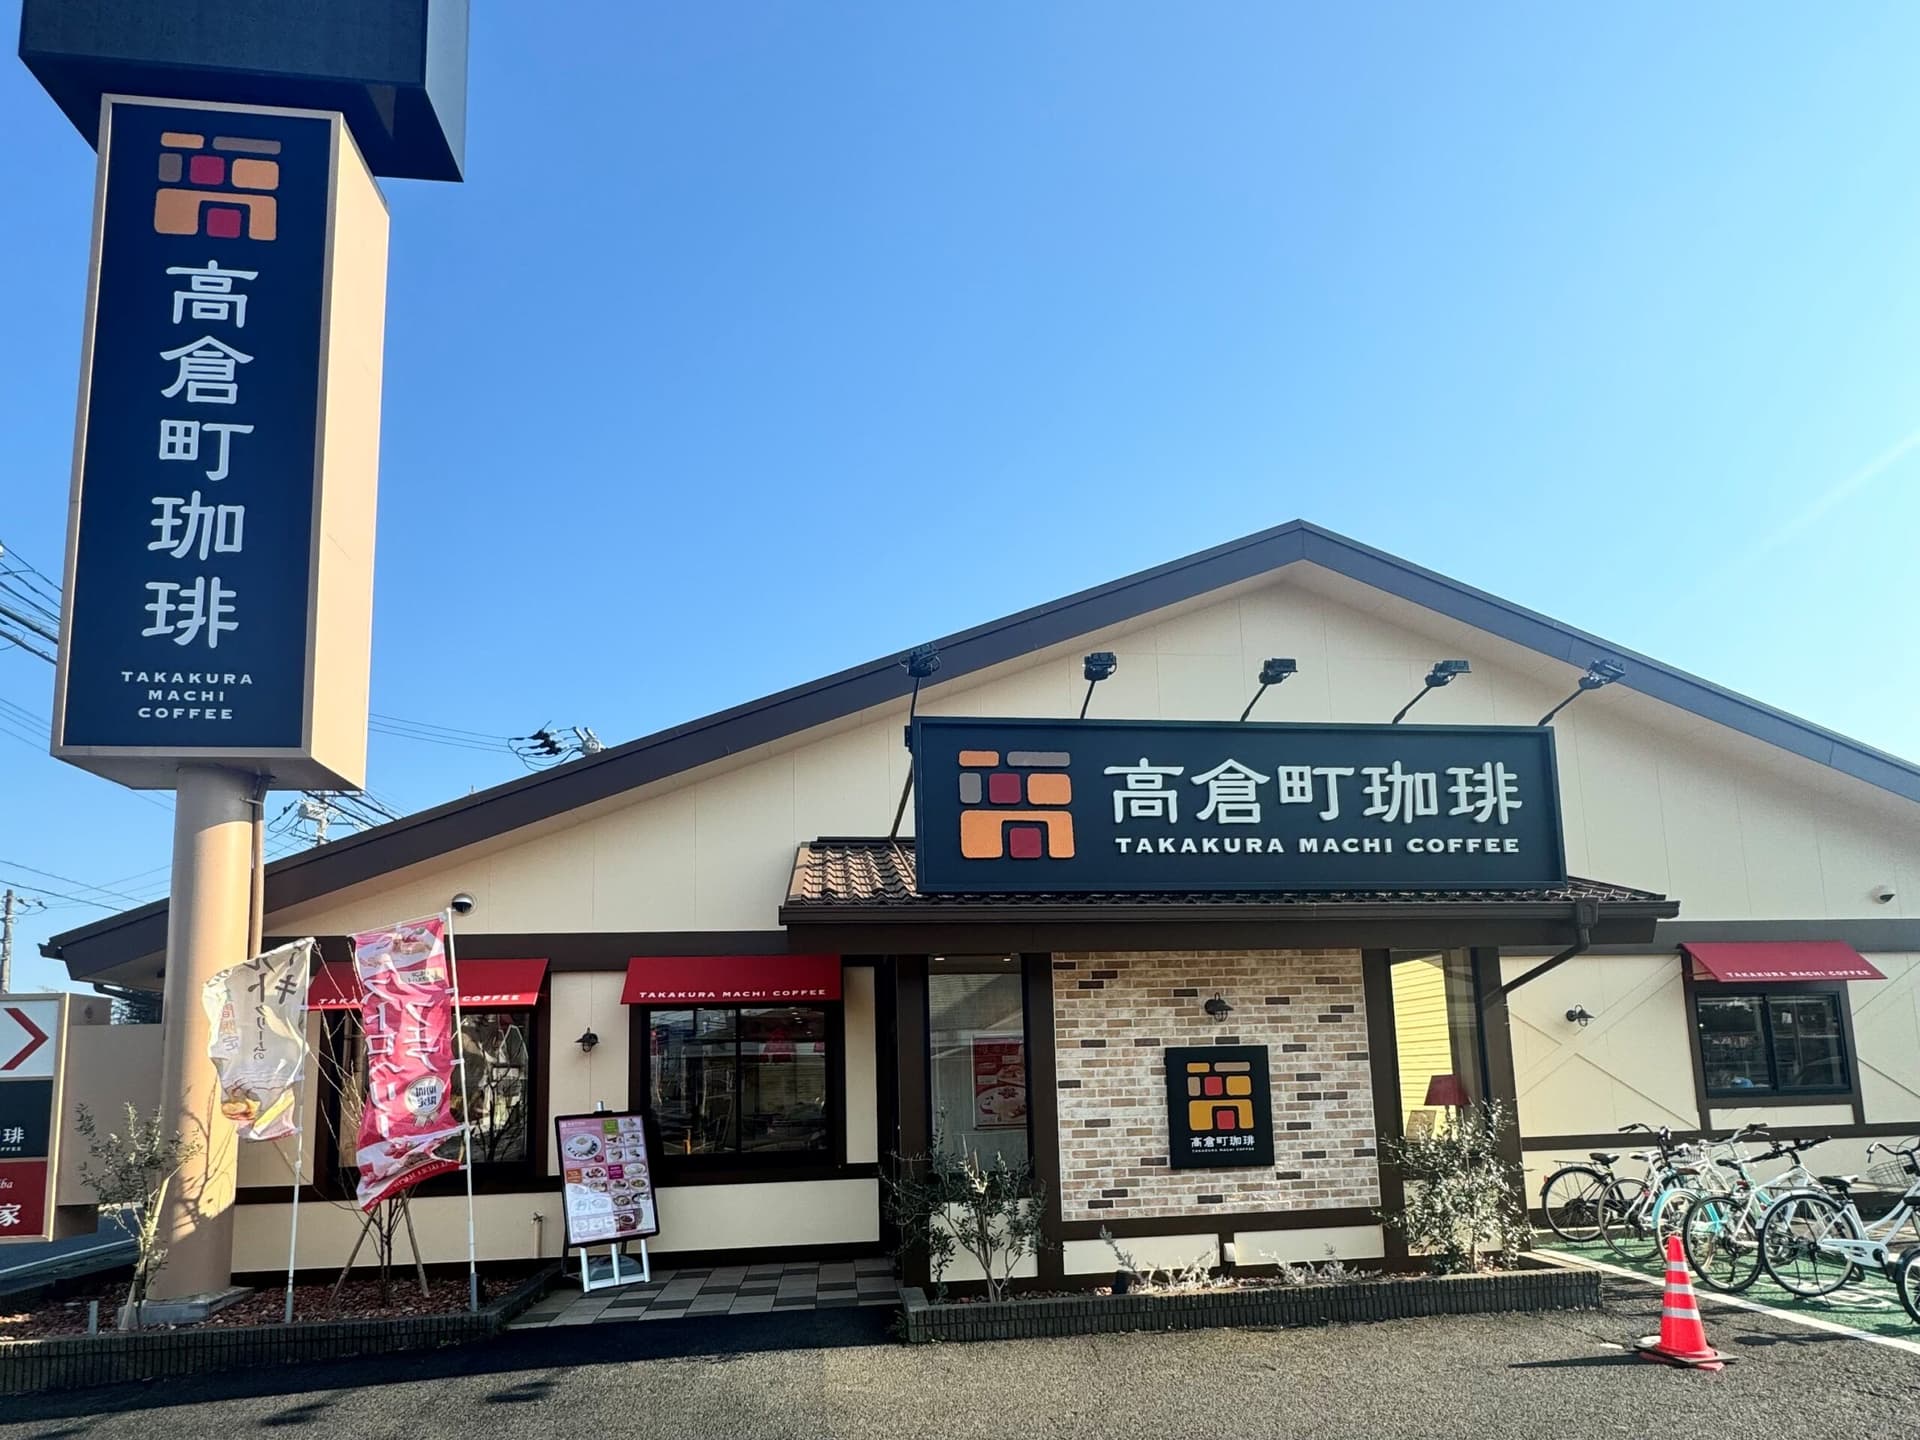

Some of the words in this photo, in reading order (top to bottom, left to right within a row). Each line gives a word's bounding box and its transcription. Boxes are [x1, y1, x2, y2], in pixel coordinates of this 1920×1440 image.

[141, 259, 259, 649] 高倉町珈琲
[121, 671, 253, 685] TAKAKURA
[148, 689, 224, 702] MACHI
[138, 707, 233, 720] COFFEE
[1103, 757, 1523, 825] 高倉町珈琲
[1114, 837, 1285, 854] TAKAKURA
[1298, 837, 1393, 854] MACHI
[1406, 837, 1520, 853] COFFEE
[639, 991, 716, 999] TAKAKURA
[1190, 1134, 1256, 1148] 高倉町珈琲
